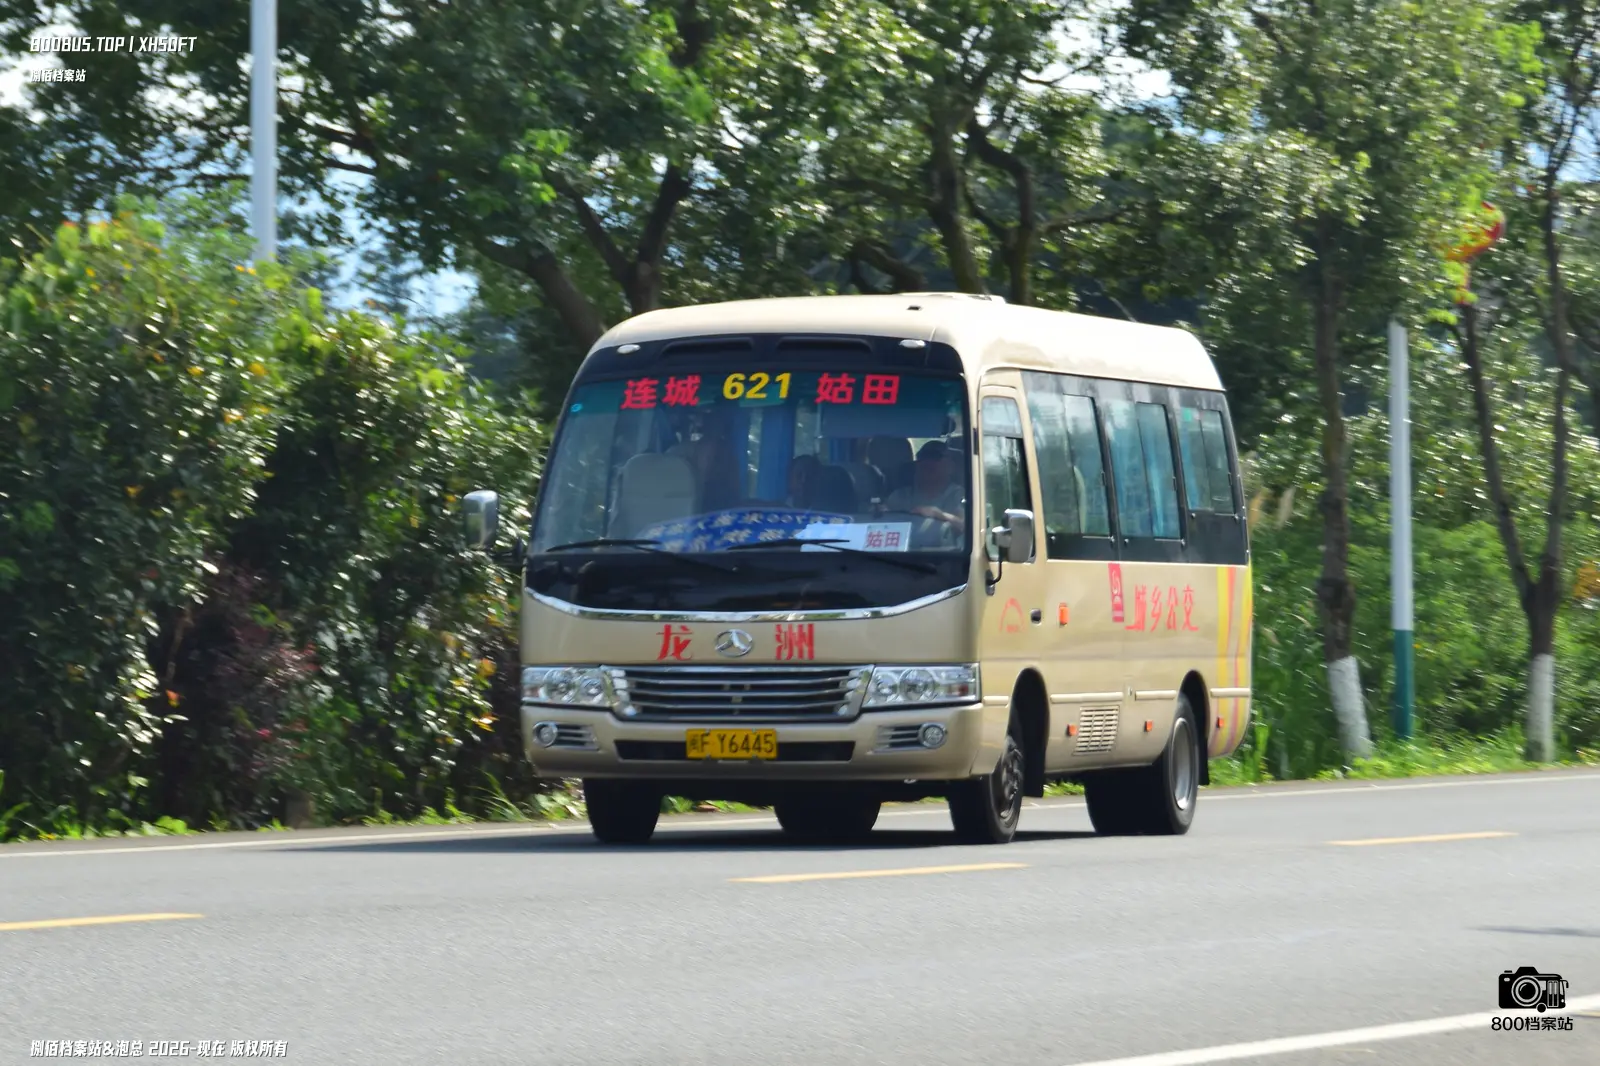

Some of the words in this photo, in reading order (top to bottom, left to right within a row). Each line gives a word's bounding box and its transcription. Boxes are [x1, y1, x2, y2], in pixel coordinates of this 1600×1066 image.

[620, 374, 701, 410] 连城
[722, 372, 792, 399] 621
[814, 373, 900, 405] 姑田
[865, 531, 901, 547] 姑田
[655, 623, 694, 661] 龙
[774, 623, 815, 661] 洲
